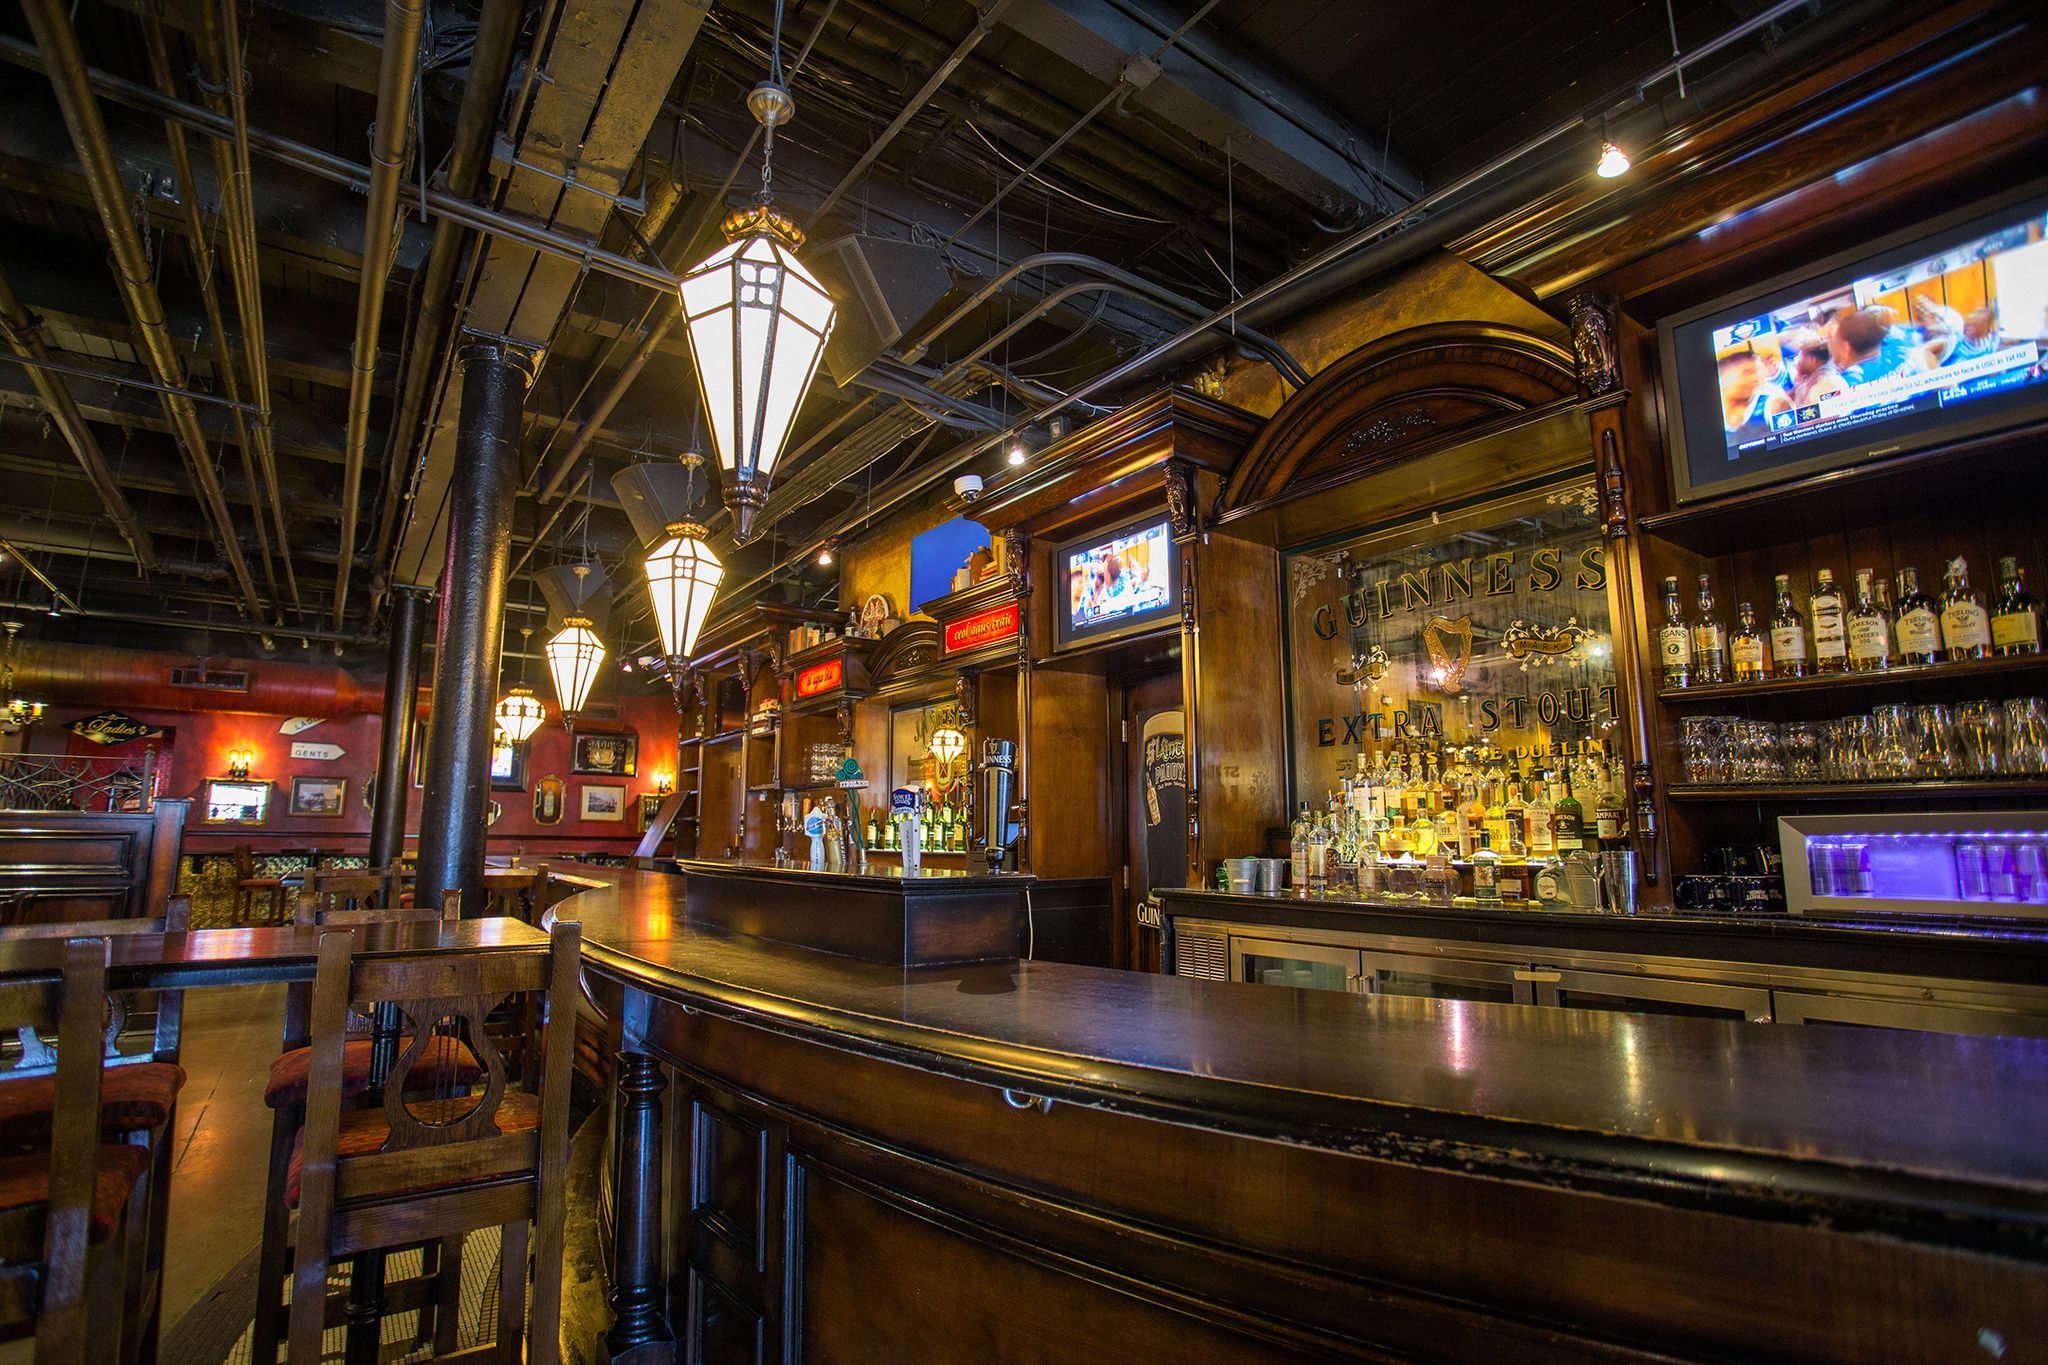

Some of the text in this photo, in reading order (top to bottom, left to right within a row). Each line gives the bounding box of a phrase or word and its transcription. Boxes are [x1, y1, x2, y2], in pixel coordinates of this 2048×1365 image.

[1312, 546, 1608, 640] GUINNESS
[1850, 620, 1880, 630] JAMESON
[1519, 640, 1560, 650] MARK
[1317, 684, 1620, 747] EXTRA STOUT
[84, 719, 137, 735] Ladies
[295, 749, 329, 758] GENTS
